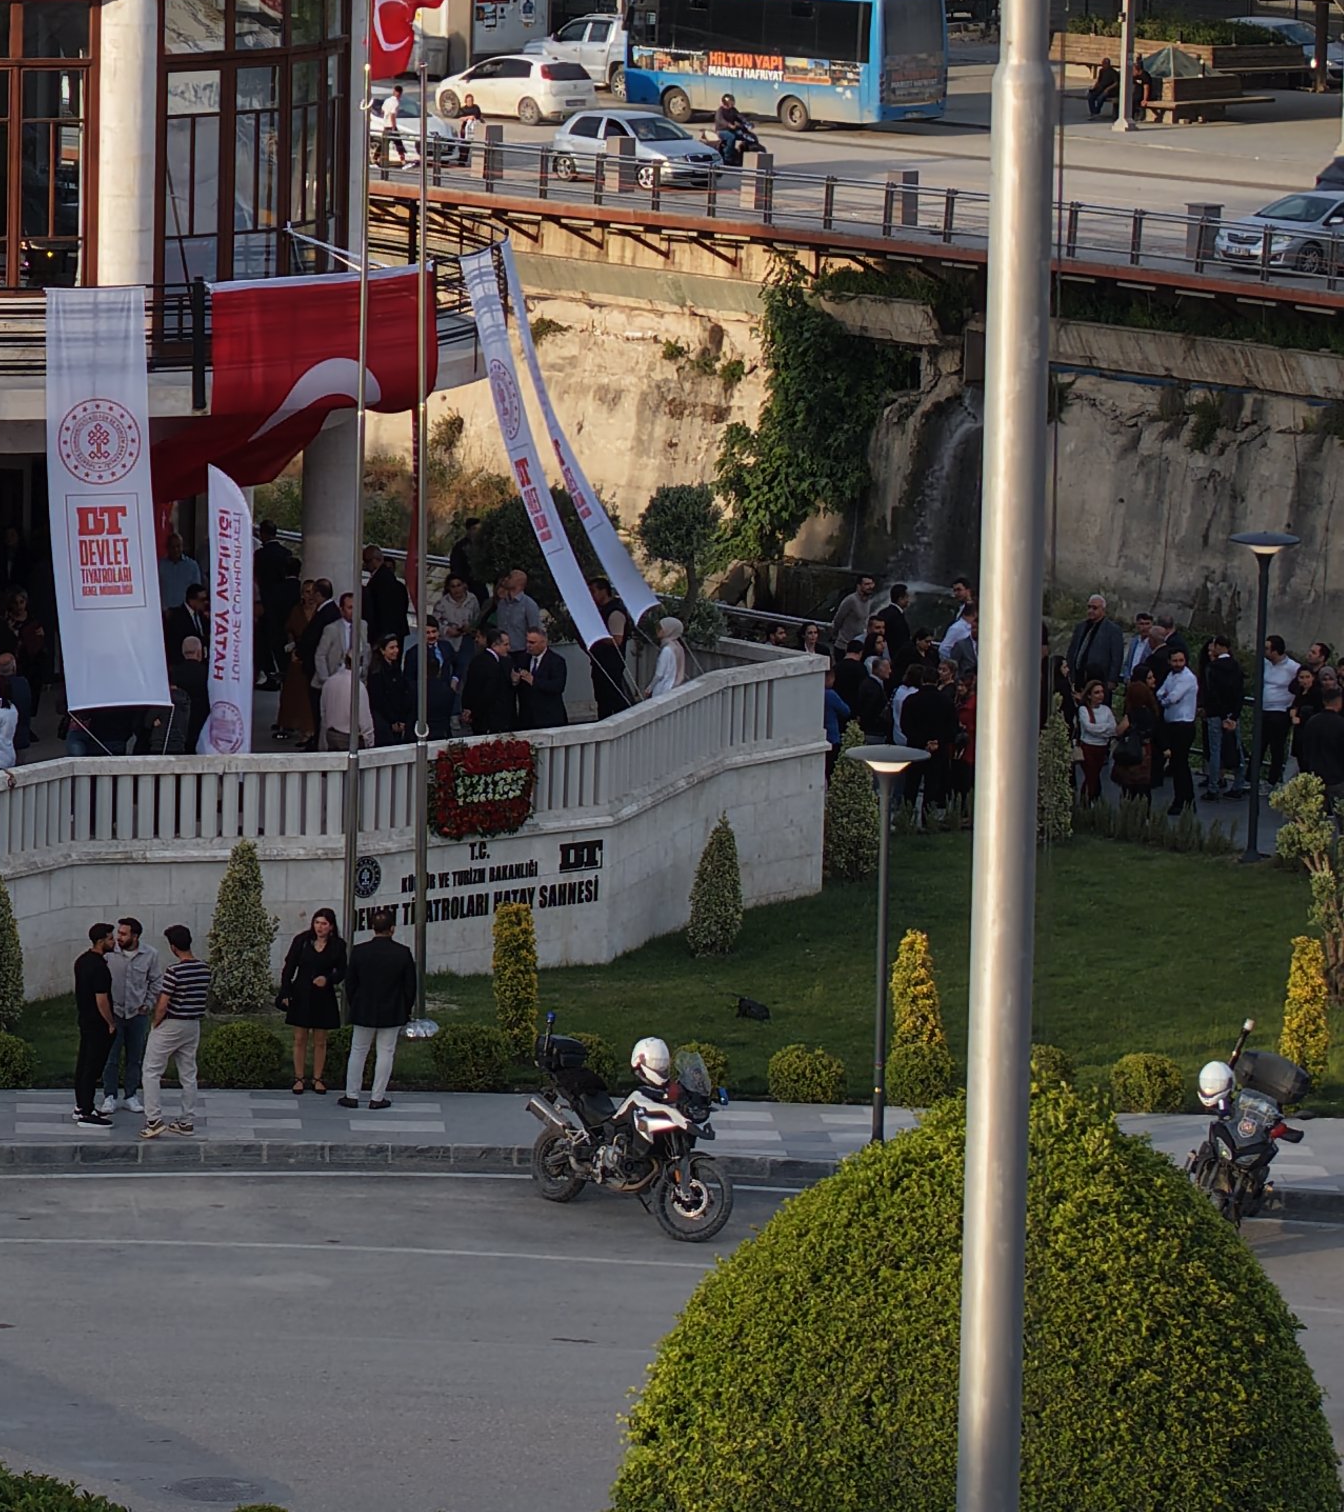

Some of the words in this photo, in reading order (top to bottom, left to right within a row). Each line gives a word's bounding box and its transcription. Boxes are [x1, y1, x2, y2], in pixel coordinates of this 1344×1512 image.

[708, 66, 743, 78] MARKET
[754, 54, 784, 70] YAPI
[76, 505, 127, 536] DT
[79, 538, 129, 566] DEVLET
[469, 841, 491, 861] T.C.
[559, 839, 604, 873] DT
[438, 872, 450, 889] VE
[452, 867, 486, 887] TURİZM
[489, 859, 538, 883] BAKANLIĞI
[402, 892, 490, 926] TİATROLARI
[538, 874, 600, 909] SAHNESİ
